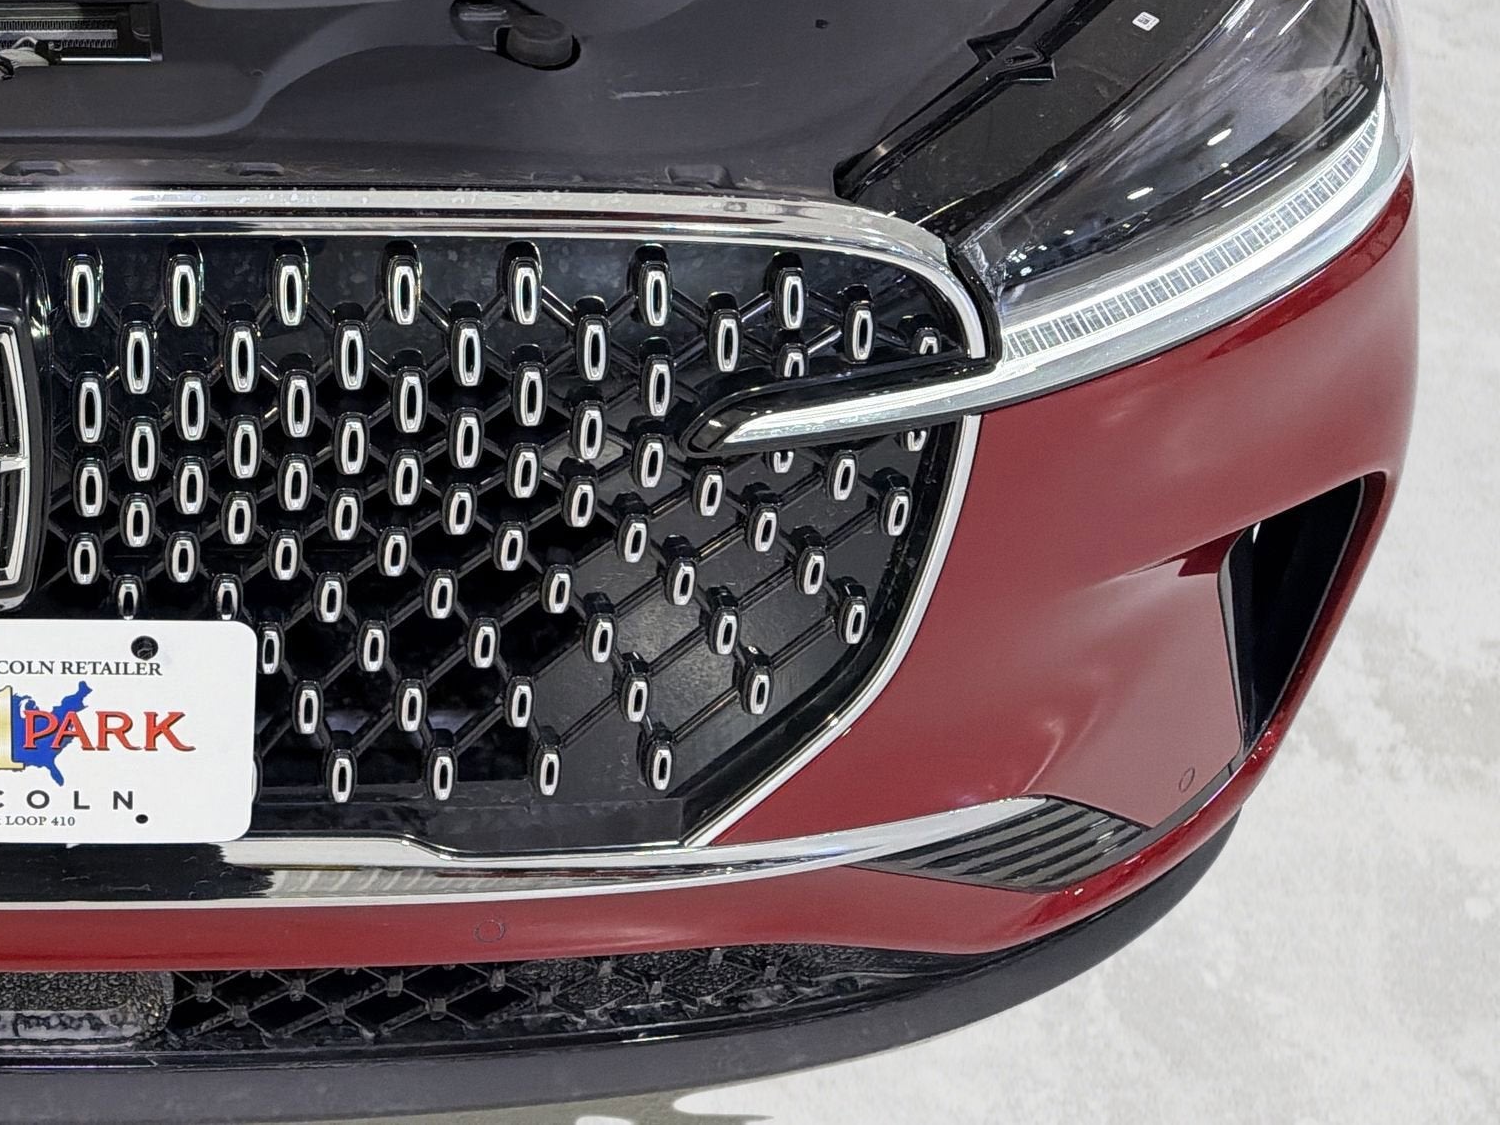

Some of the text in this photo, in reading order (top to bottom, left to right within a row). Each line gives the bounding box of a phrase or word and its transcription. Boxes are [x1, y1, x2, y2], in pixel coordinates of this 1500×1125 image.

[60, 660, 163, 676] RETAILER
[23, 708, 196, 753] PARK
[5, 815, 47, 826] LOOP
[51, 815, 76, 827] 410
